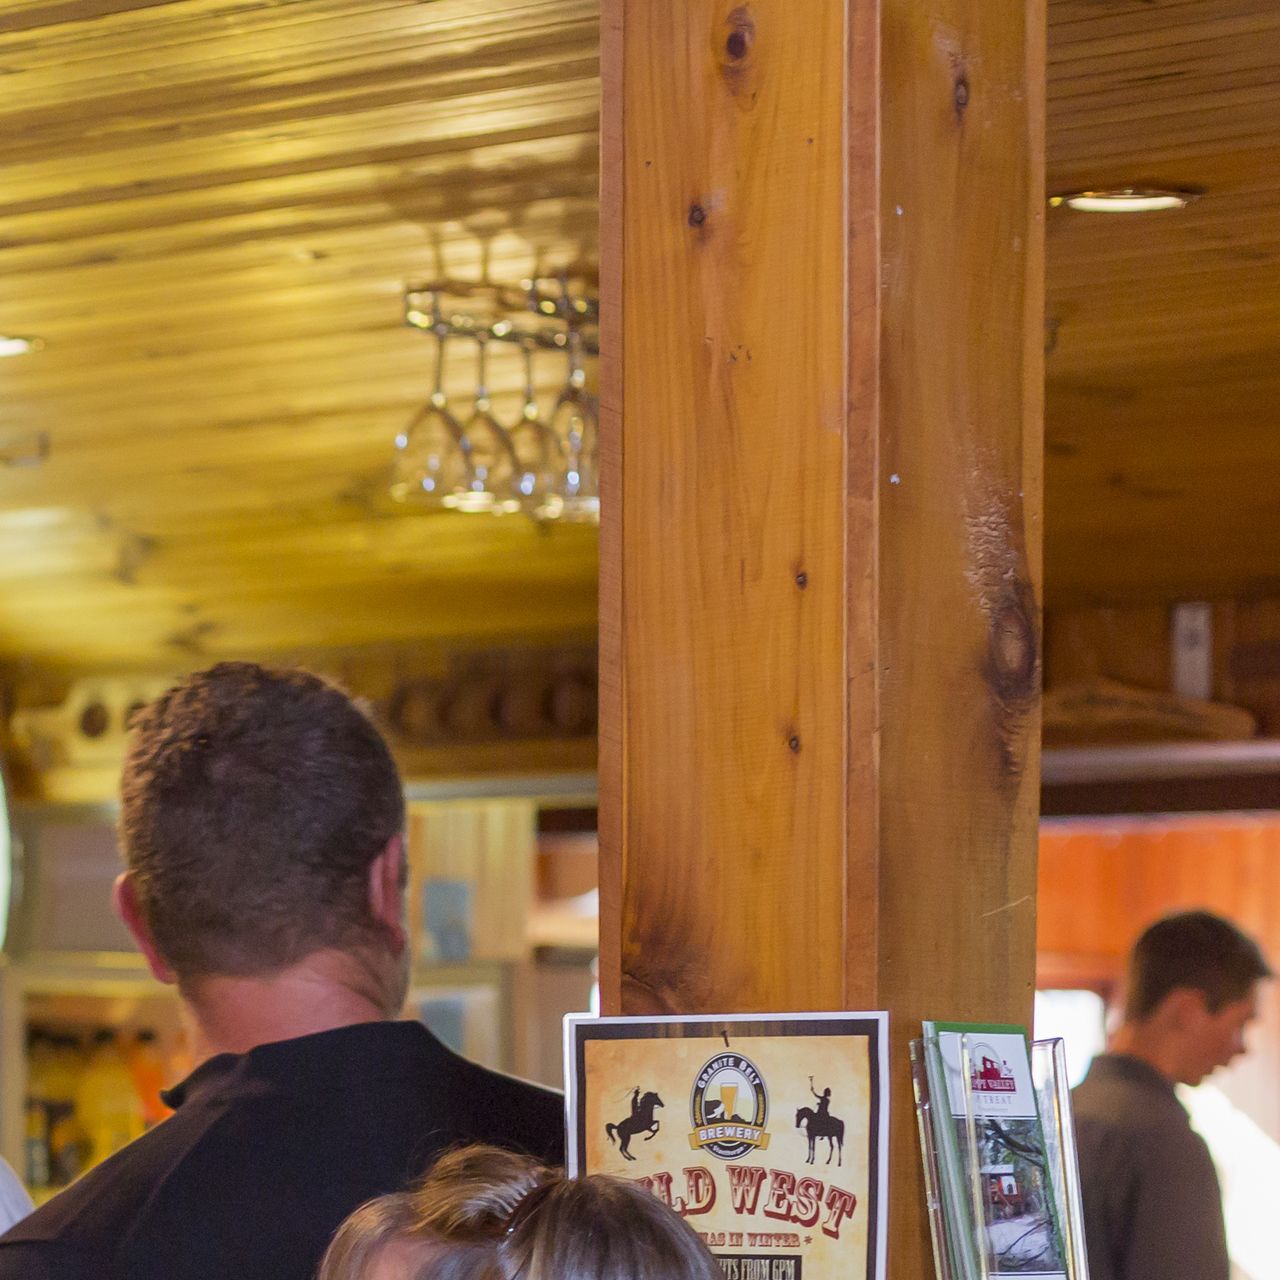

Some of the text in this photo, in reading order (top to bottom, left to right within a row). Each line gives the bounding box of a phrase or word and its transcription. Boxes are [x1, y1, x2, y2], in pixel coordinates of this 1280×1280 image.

[697, 1057, 759, 1088] GRANITE BELT
[699, 1126, 761, 1140] BREWERY
[726, 1165, 856, 1240] WEST
[729, 1232, 743, 1247] IN
[747, 1233, 800, 1247] WINTER
[741, 1259, 769, 1280] FROM
[772, 1260, 795, 1280] 6PM
